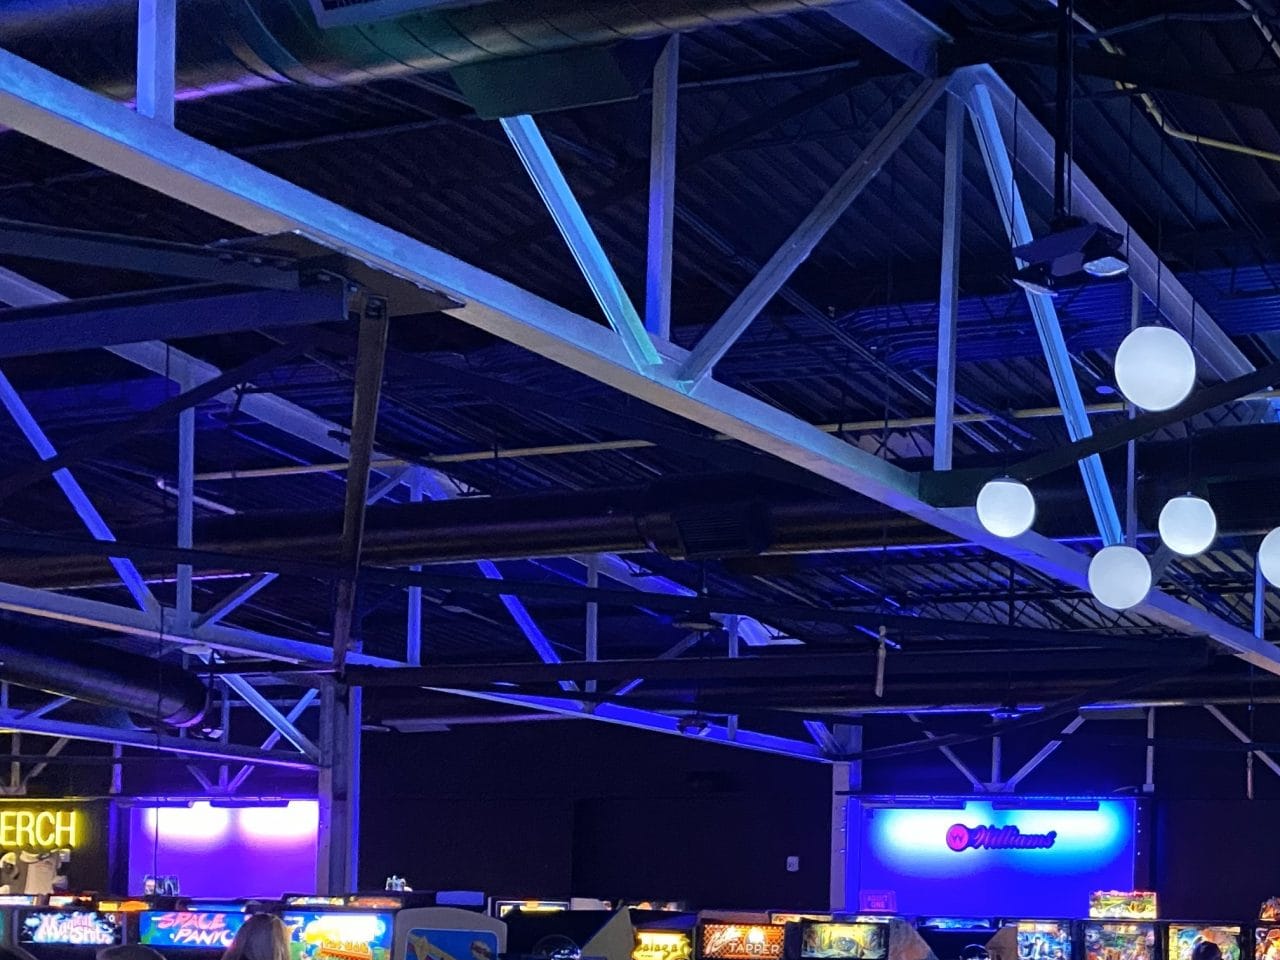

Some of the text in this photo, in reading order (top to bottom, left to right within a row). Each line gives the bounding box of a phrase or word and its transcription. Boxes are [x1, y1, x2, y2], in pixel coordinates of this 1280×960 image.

[971, 825, 1057, 849] Williams
[158, 911, 226, 930] SPACE
[173, 928, 234, 947] PANIC
[729, 942, 780, 954] TAPPER
